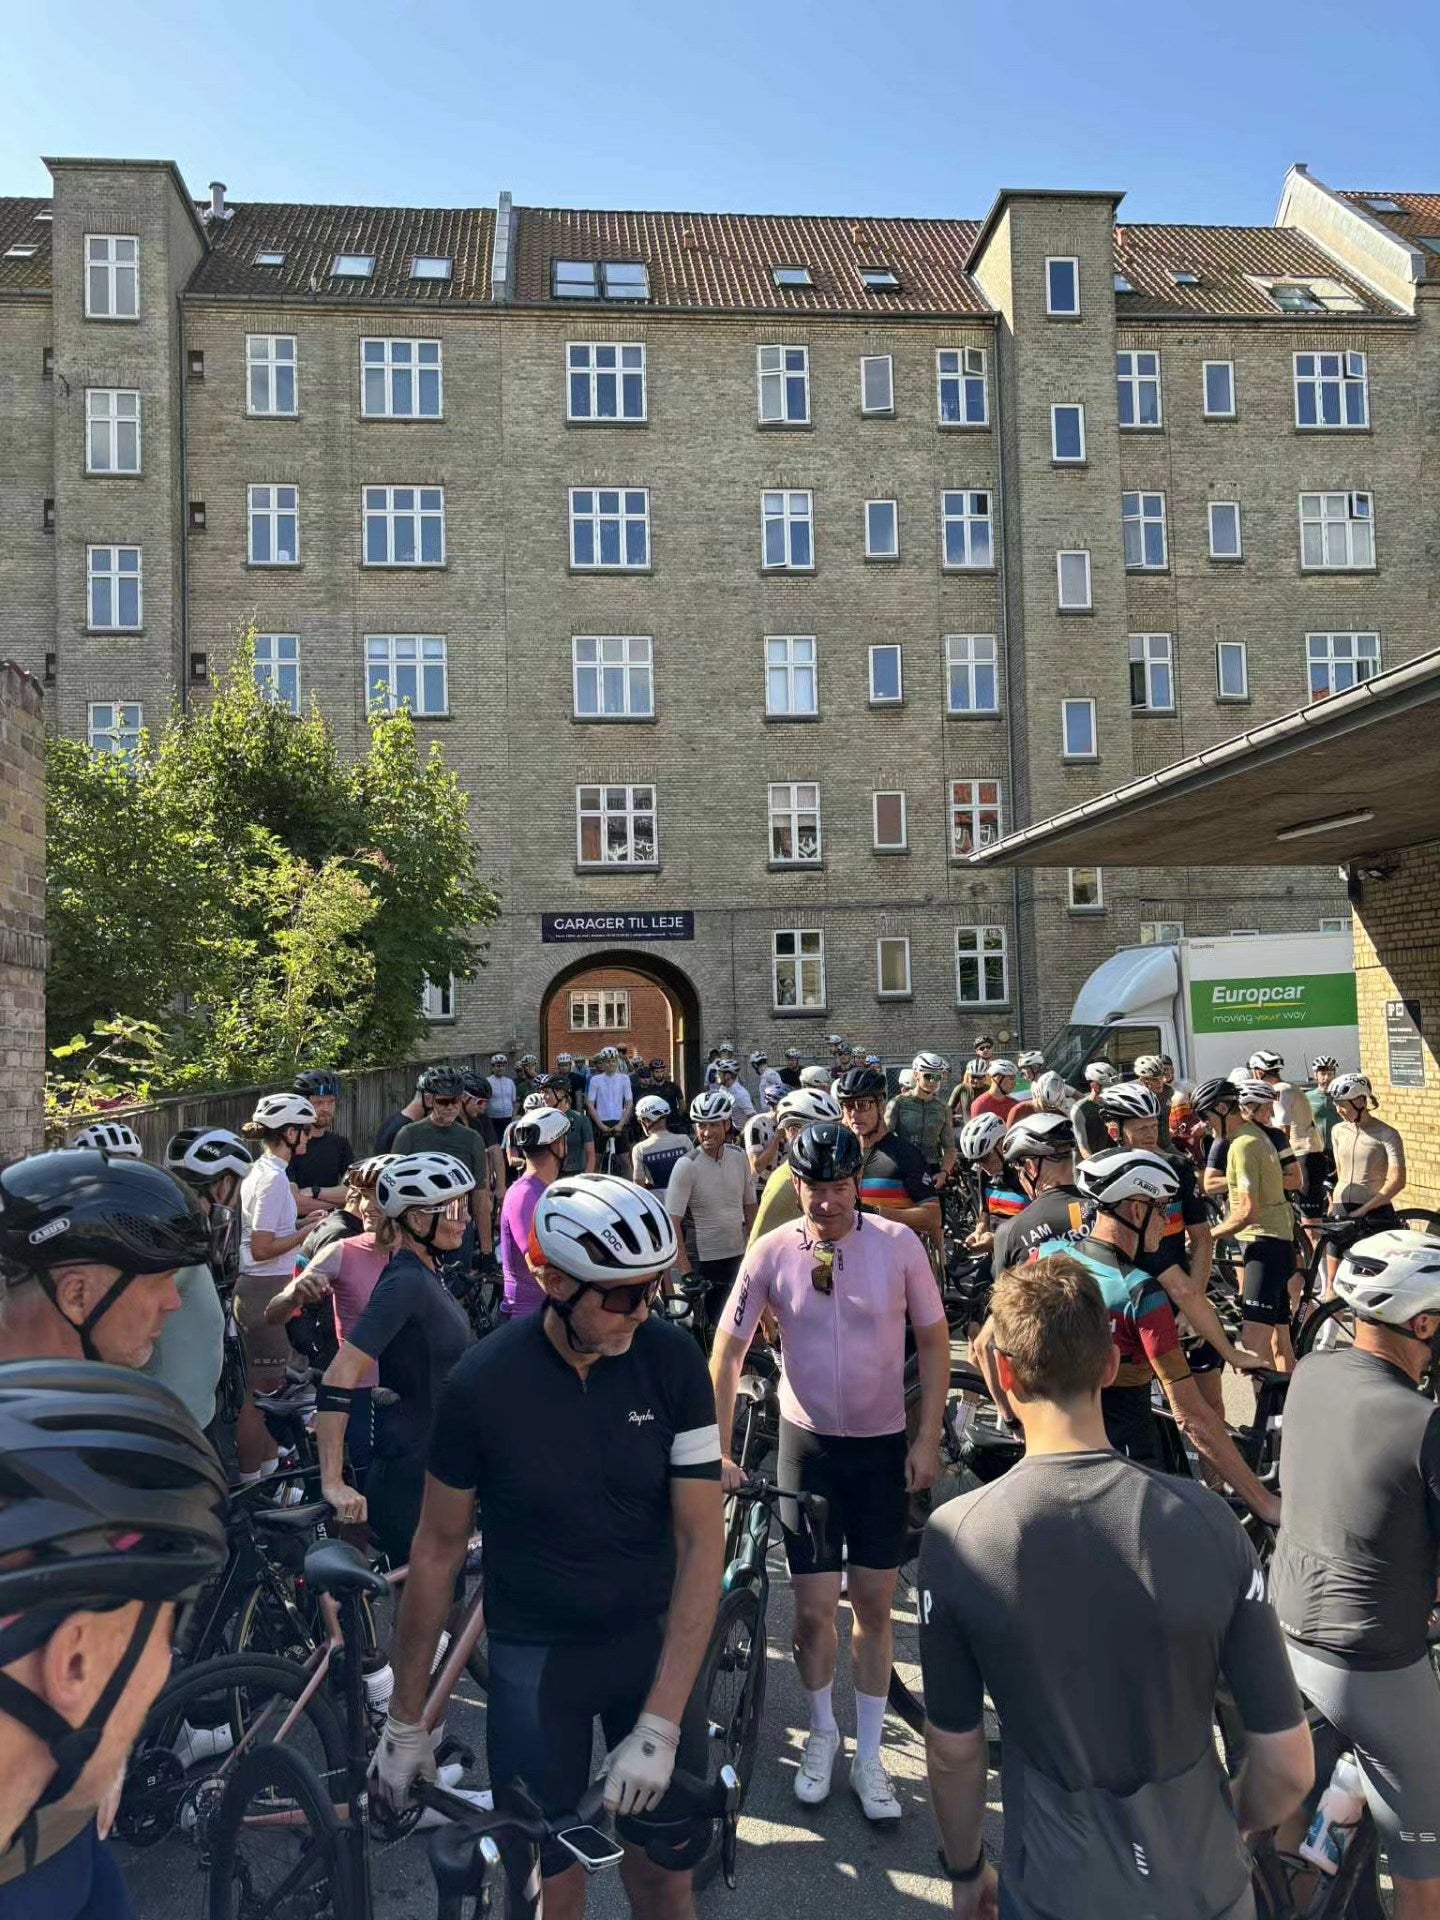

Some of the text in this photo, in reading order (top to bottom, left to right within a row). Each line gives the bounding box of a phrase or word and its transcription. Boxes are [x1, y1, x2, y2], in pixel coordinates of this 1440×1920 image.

[554, 916, 684, 930] GARAGER TIL LEJE
[1212, 984, 1306, 1007] Europcar
[1213, 1010, 1306, 1025] moving your way
[601, 1229, 622, 1251] POC
[1020, 1234, 1029, 1247] I
[1030, 1223, 1052, 1243] AM
[628, 1409, 655, 1426] Rapha
[1244, 1568, 1265, 1603] M
